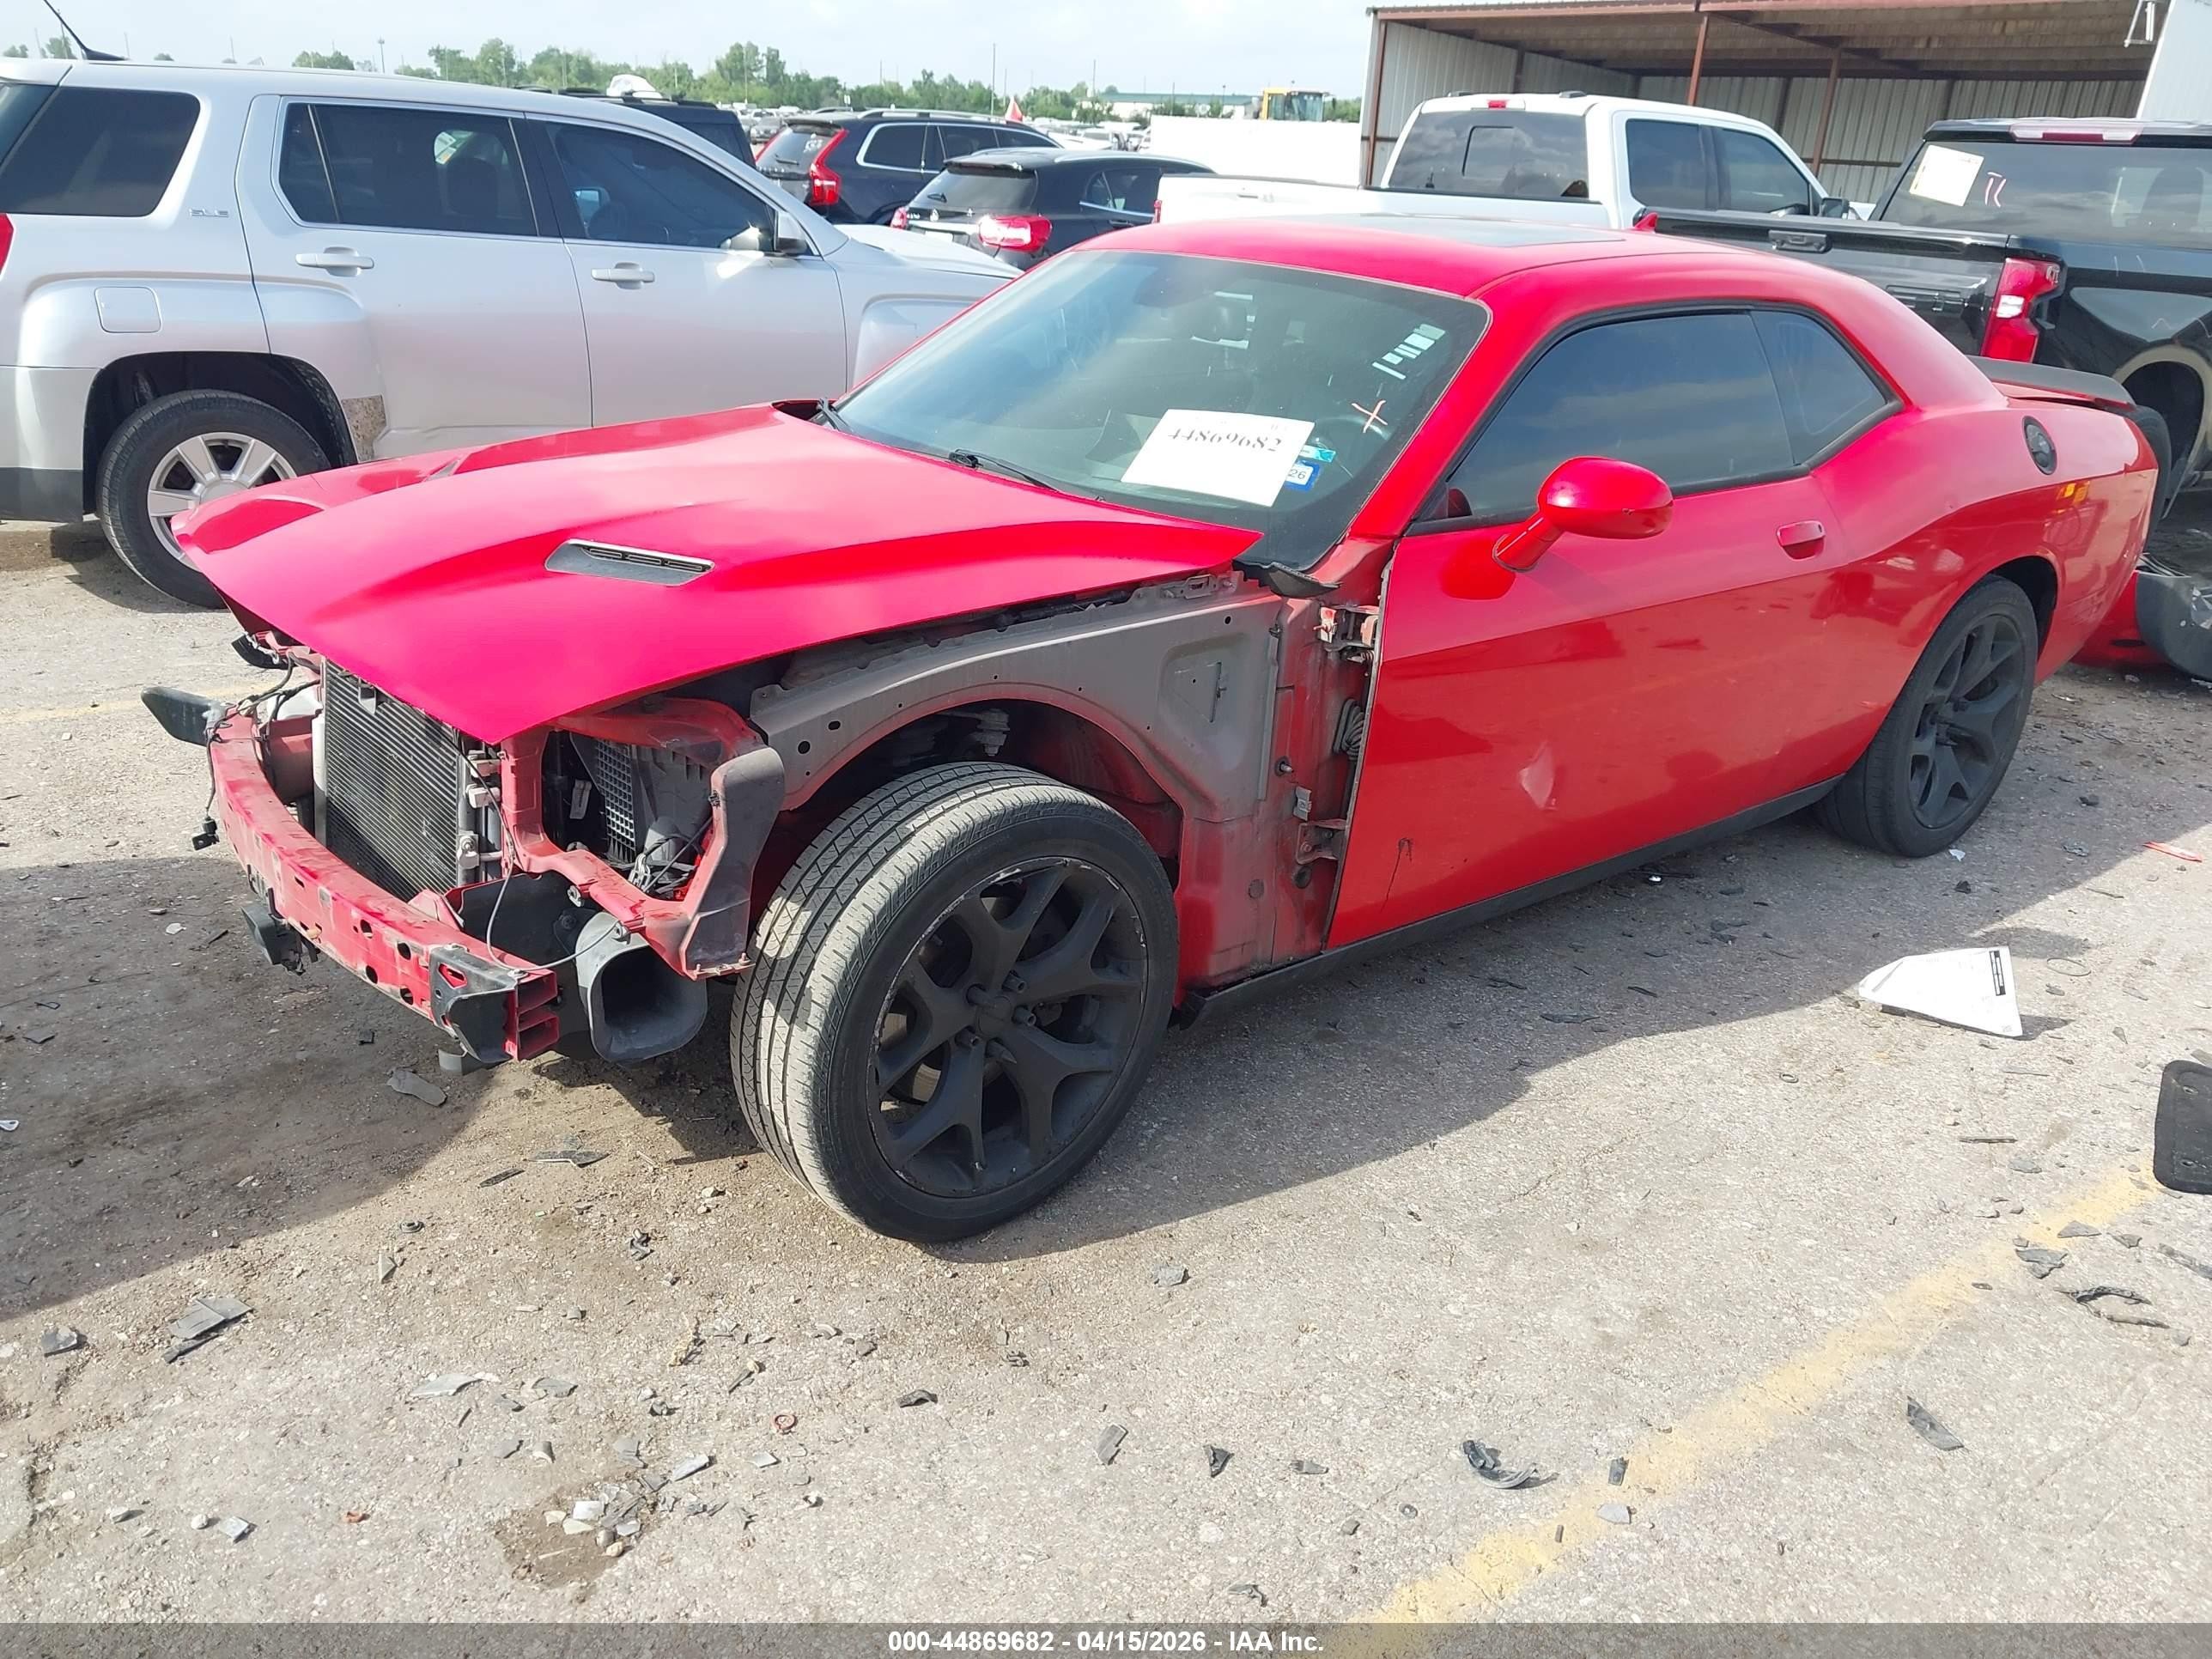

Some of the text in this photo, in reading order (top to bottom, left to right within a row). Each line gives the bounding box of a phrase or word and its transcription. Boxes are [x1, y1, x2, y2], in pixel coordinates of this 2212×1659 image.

[189, 209, 228, 217] SLE
[1168, 428, 1282, 452] 44869682
[1288, 468, 1307, 480] 26
